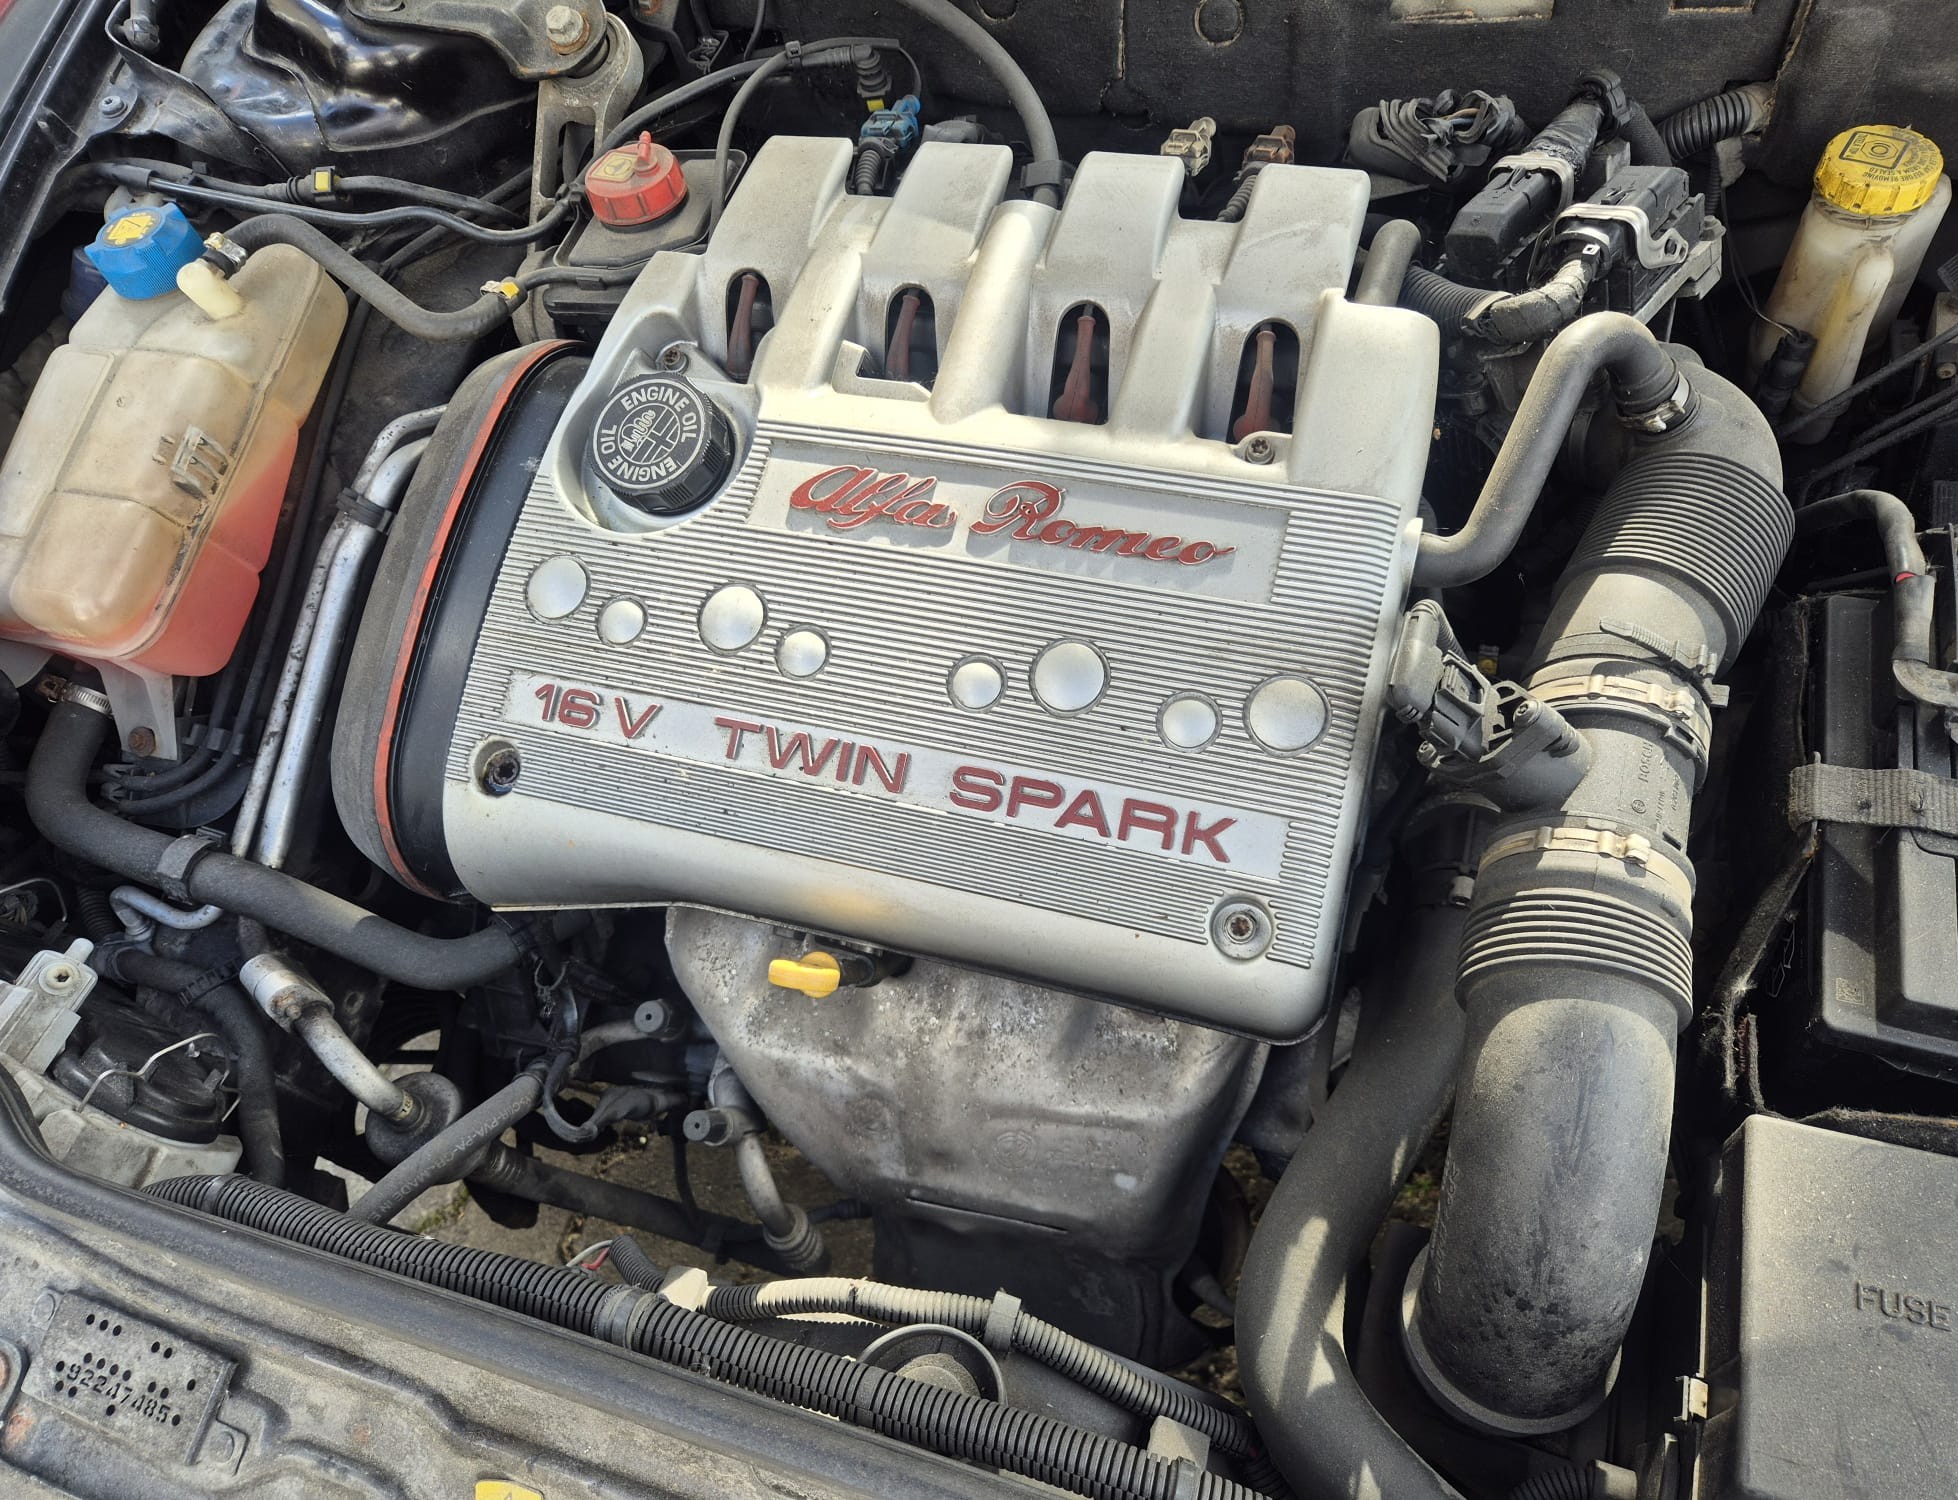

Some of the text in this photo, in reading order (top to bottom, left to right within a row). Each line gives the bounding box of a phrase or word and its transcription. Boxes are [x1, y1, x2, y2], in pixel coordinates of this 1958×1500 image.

[620, 386, 698, 442] ENGINE OIL
[600, 424, 678, 482] ENGINE OIL
[789, 465, 1237, 566] Alfa Romeo
[714, 715, 912, 793] TWIN
[949, 765, 1238, 864] SPARK
[1856, 1280, 1952, 1332] FUSE
[67, 1363, 171, 1423] 92247485
